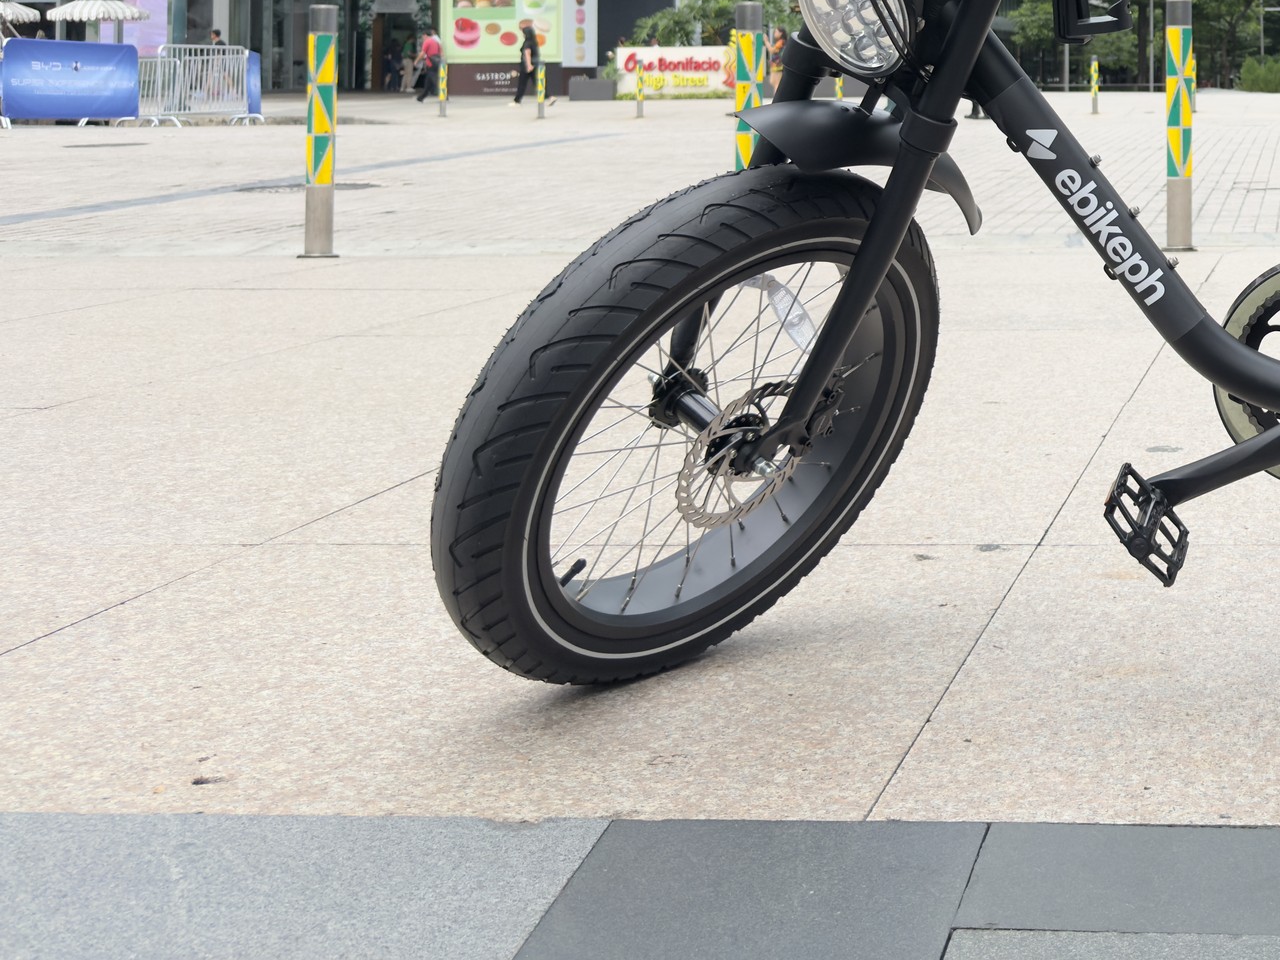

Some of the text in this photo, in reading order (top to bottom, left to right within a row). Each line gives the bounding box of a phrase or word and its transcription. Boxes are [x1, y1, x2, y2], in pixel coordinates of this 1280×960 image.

[31, 61, 62, 71] BYD
[658, 56, 721, 72] Bonifacio
[671, 73, 708, 88] Street
[1055, 168, 1166, 307] ebikeph
